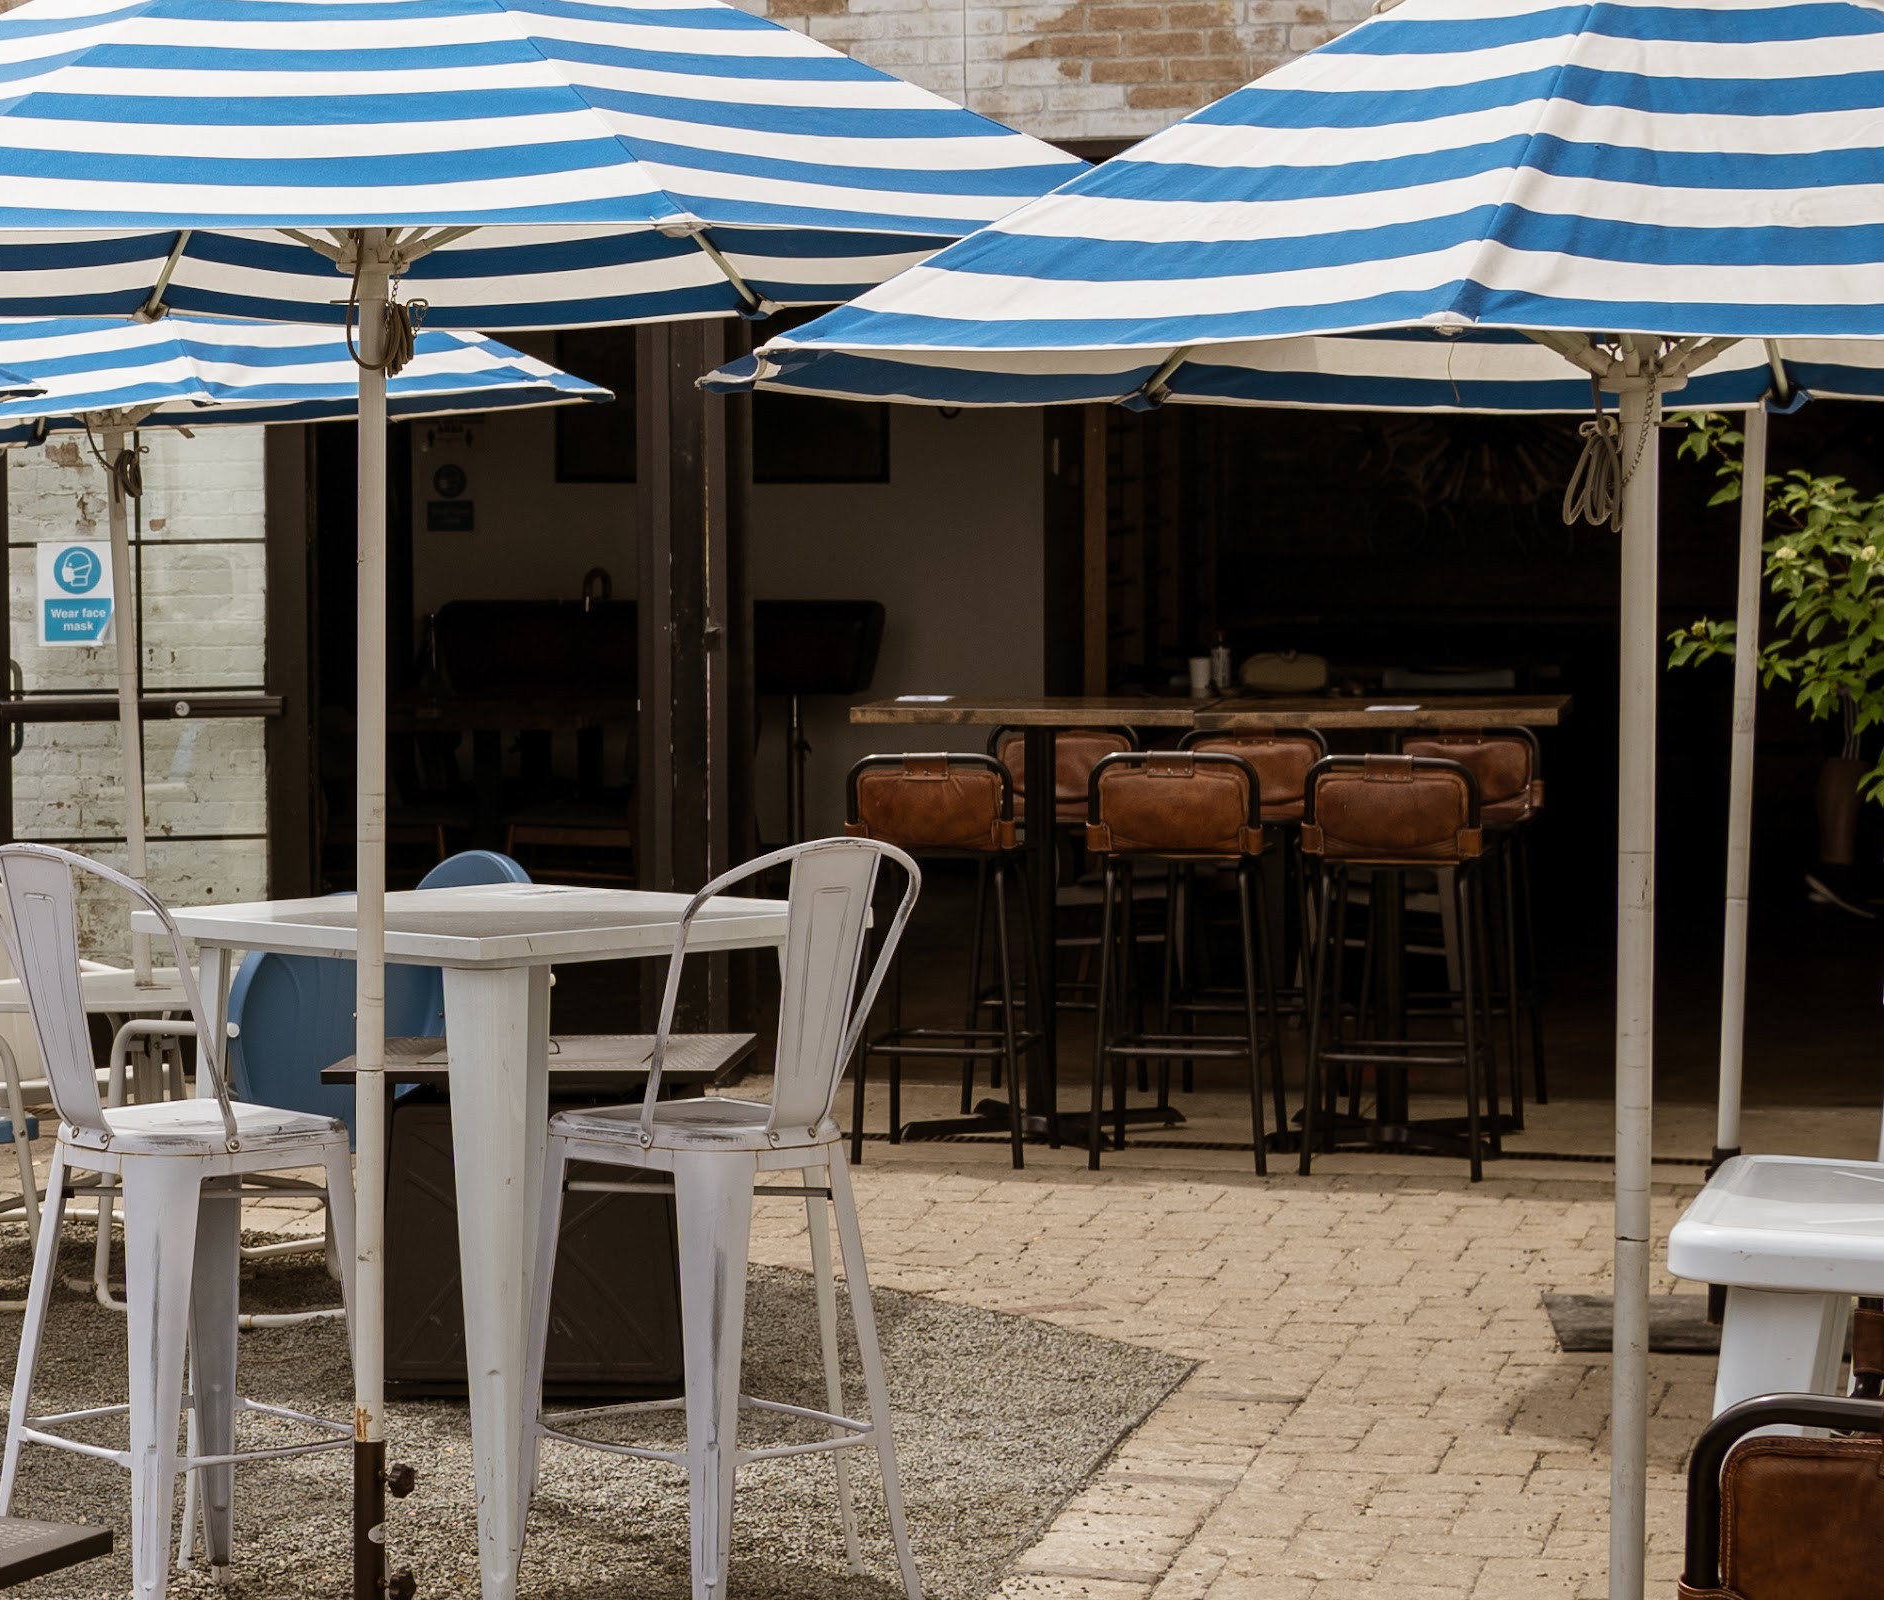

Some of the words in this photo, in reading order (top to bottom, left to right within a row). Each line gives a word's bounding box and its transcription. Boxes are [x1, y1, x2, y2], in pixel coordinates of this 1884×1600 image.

[50, 608, 79, 618] Wear
[82, 608, 106, 618] face
[63, 621, 94, 631] mask
